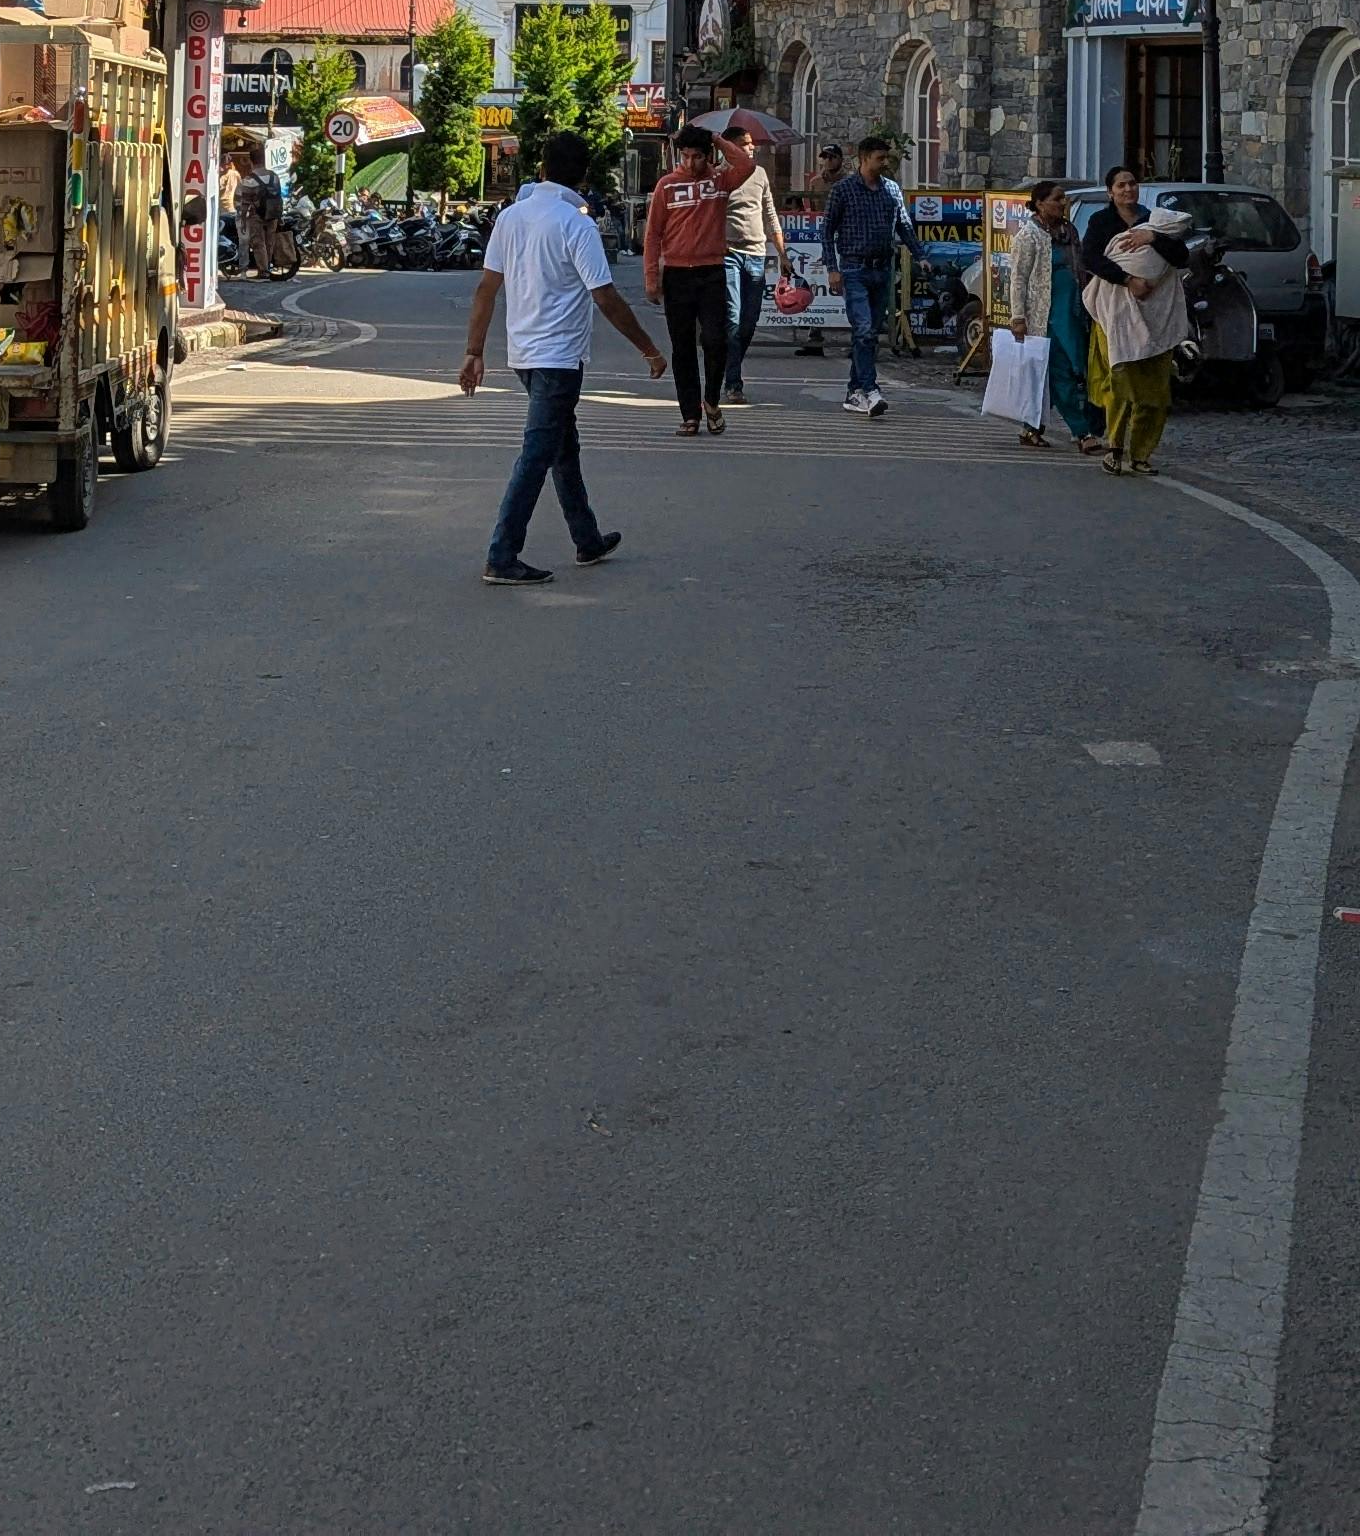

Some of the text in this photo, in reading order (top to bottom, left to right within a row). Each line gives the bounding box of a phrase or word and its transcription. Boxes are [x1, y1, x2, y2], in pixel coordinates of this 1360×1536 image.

[332, 120, 355, 137] 20
[953, 198, 972, 211] NO
[184, 130, 206, 303] TAGET
[766, 316, 825, 325] 79003-79003
